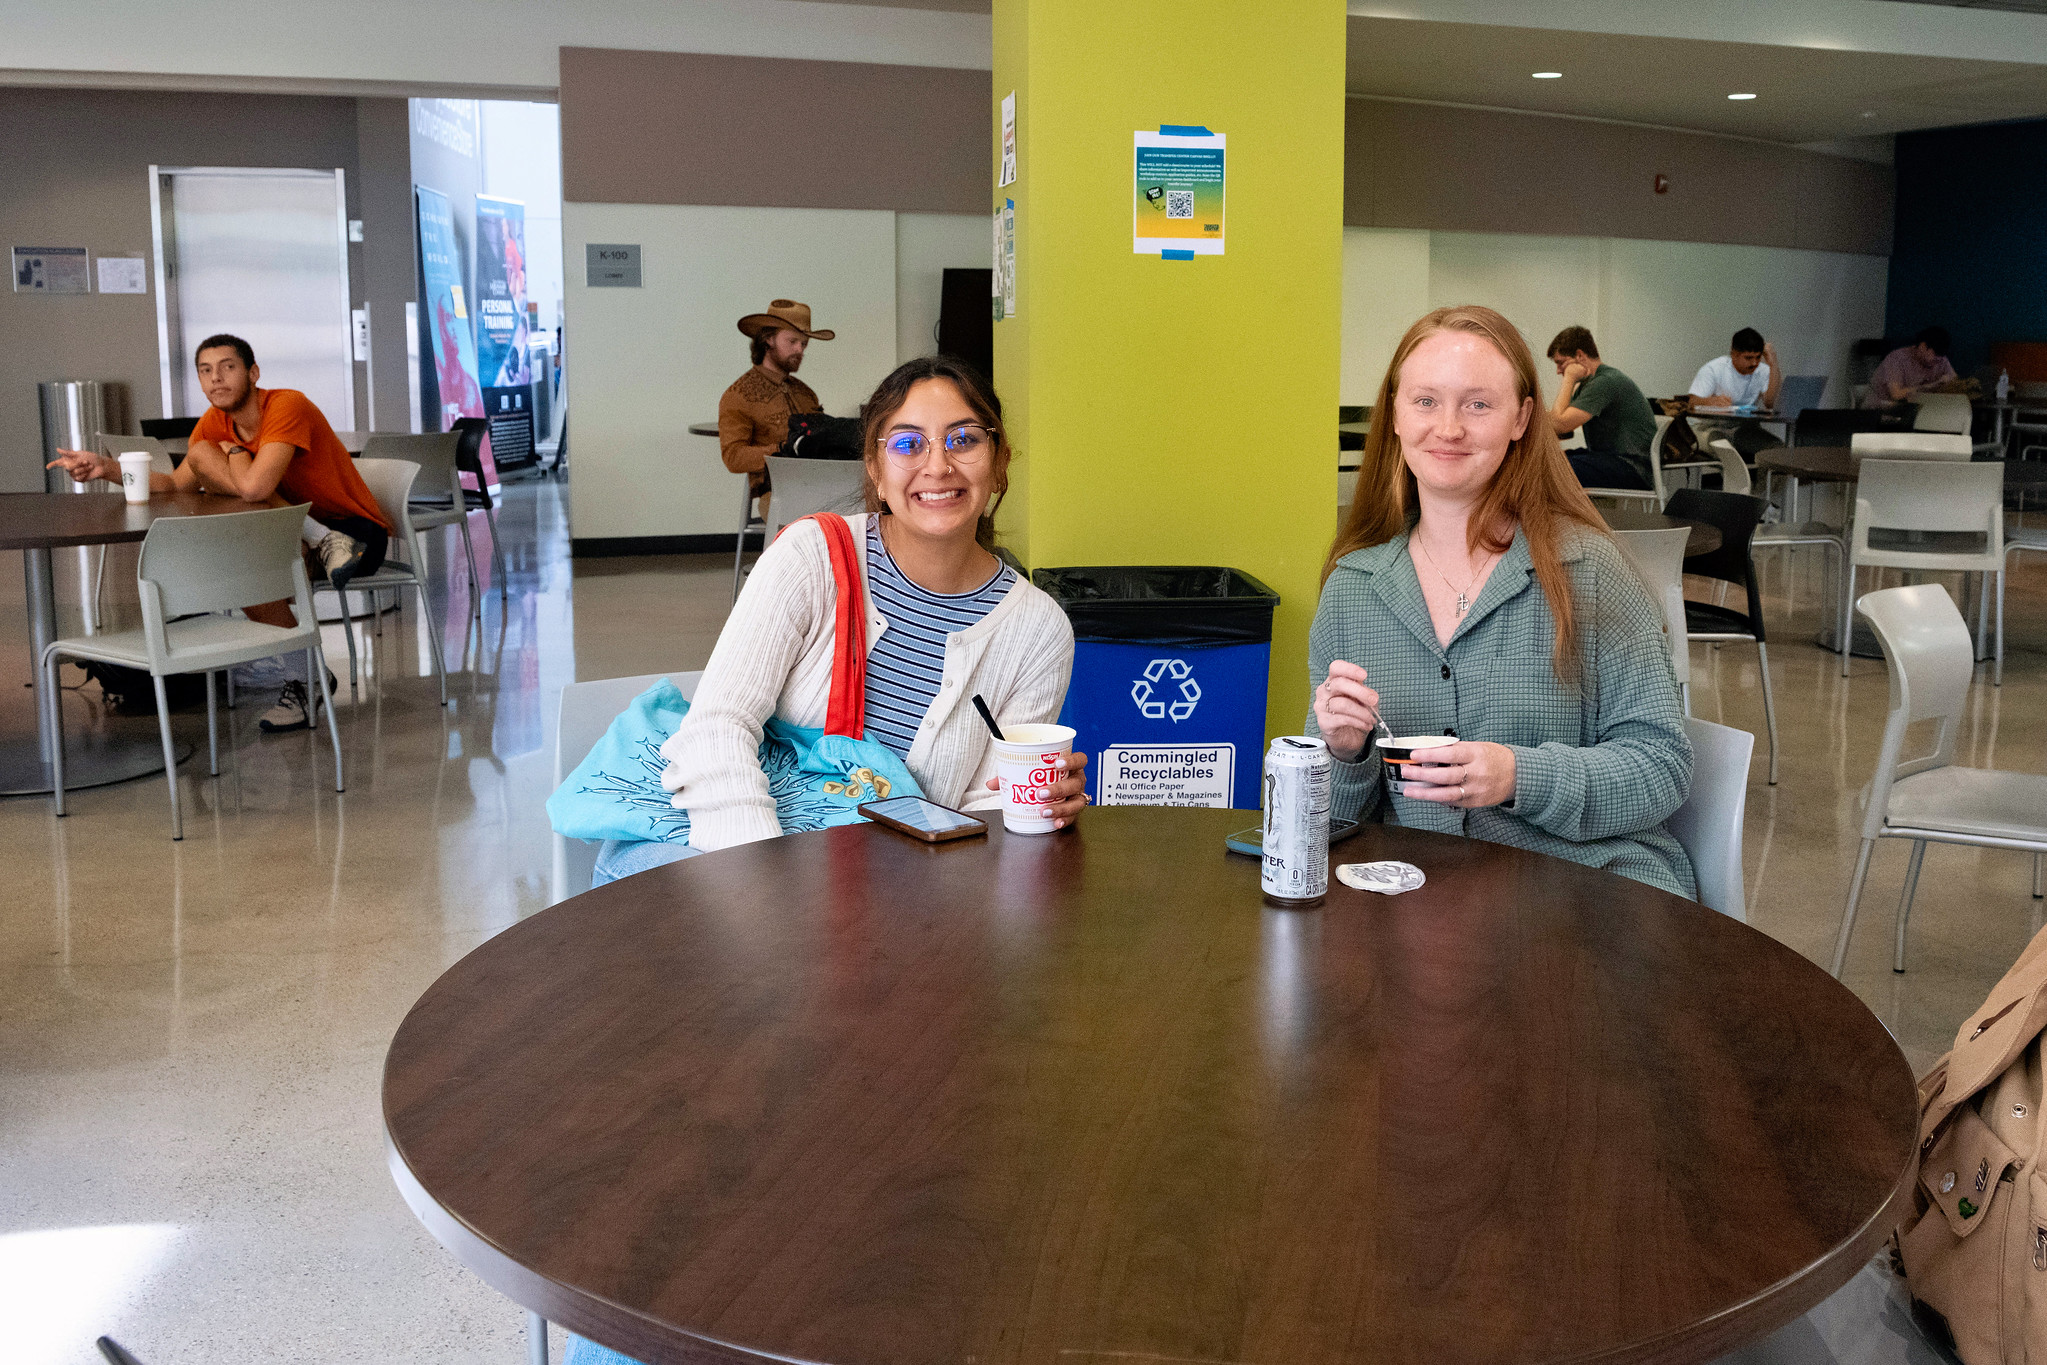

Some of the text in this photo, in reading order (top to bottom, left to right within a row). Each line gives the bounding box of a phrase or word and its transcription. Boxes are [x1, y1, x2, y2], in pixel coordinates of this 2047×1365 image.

[600, 251, 628, 260] K-100
[481, 299, 514, 313] PERSONAL
[483, 315, 514, 330] TRAINING
[1118, 750, 1218, 766] Commingled
[1120, 766, 1214, 782] Recyclables
[1159, 783, 1185, 791] Paper
[1115, 792, 1165, 801] Newspaper
[1176, 791, 1223, 800] Magazines
[1292, 870, 1299, 880] 0
